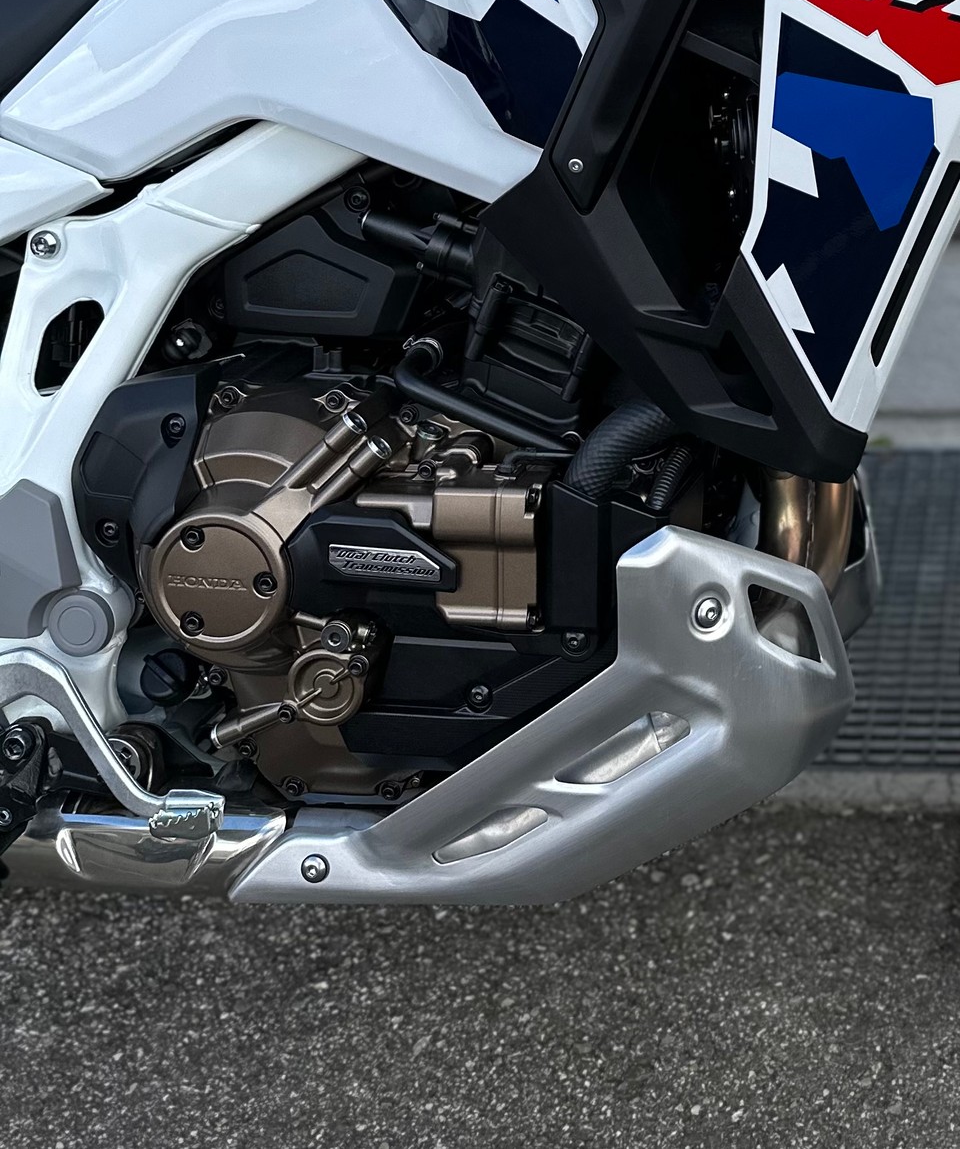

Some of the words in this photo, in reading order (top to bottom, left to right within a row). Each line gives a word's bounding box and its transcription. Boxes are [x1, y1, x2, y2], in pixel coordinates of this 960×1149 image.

[336, 550, 372, 560] Dual
[372, 551, 416, 564] Clutch
[341, 560, 435, 576] Transmission
[167, 574, 247, 591] HONDA
